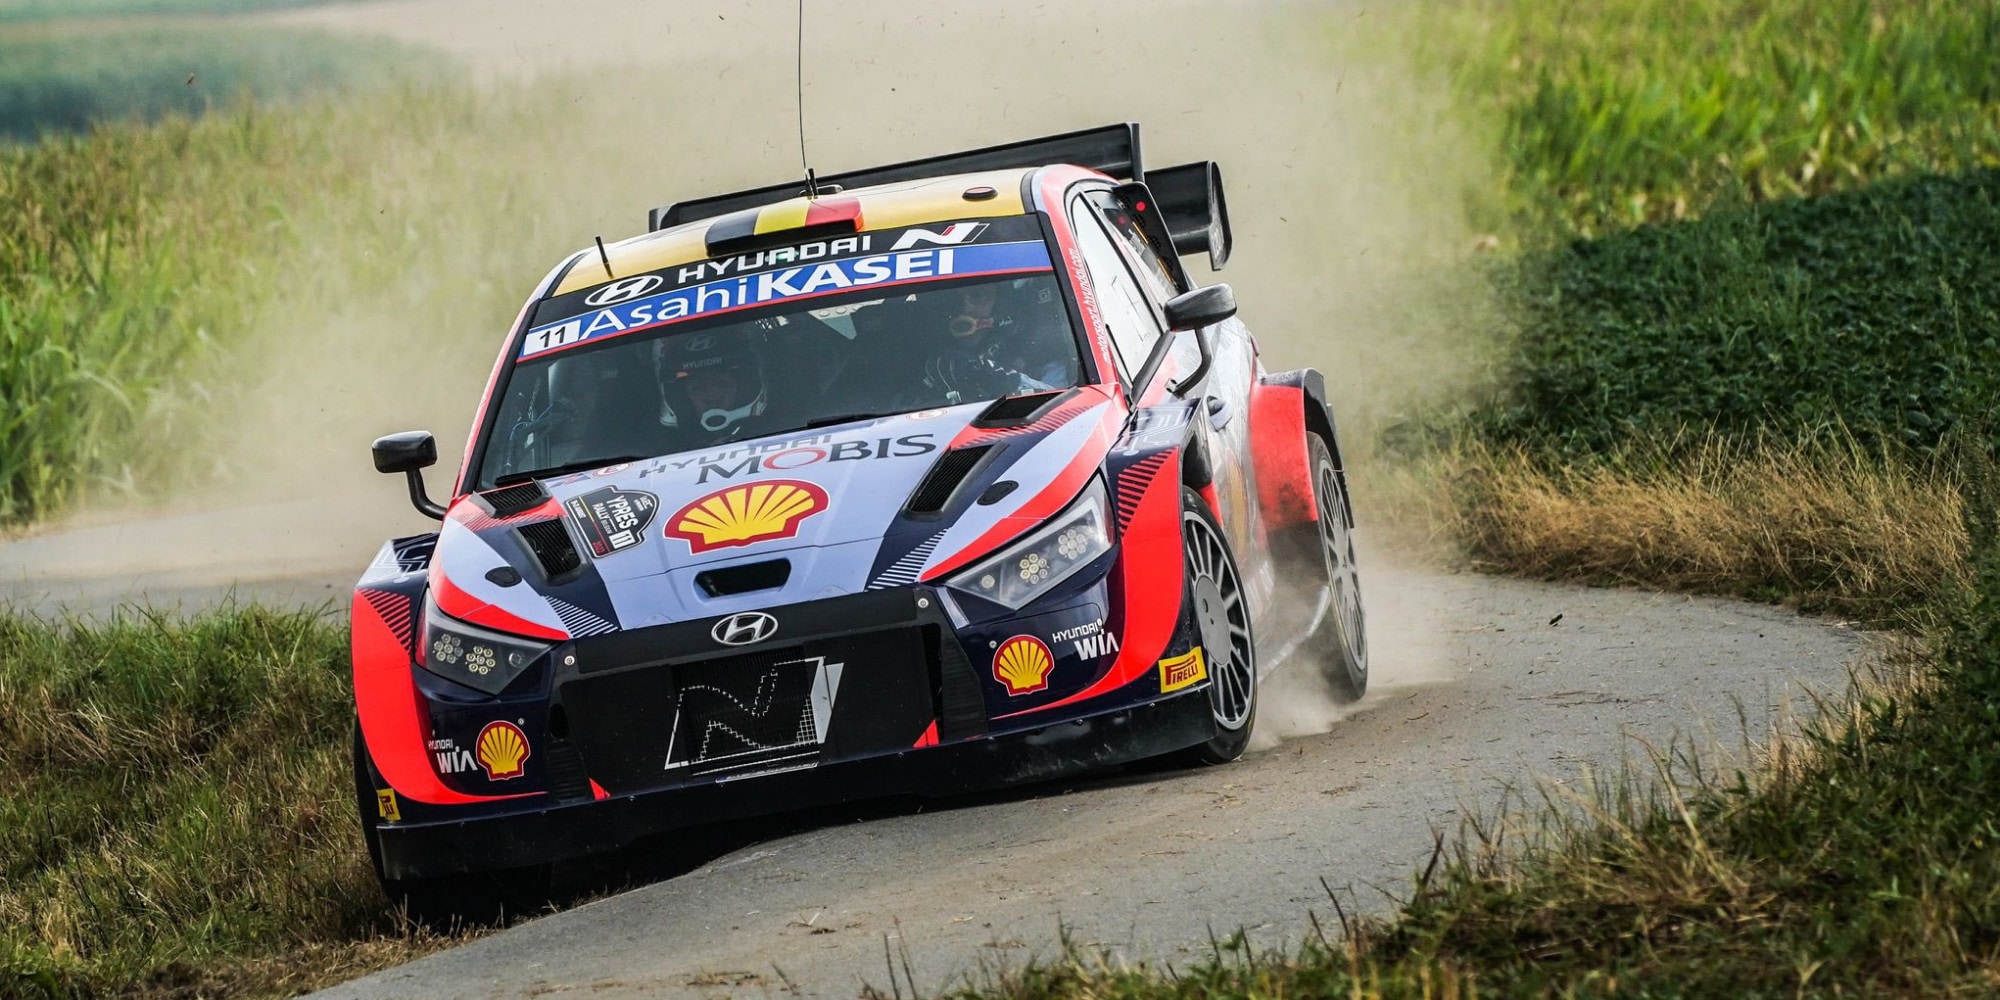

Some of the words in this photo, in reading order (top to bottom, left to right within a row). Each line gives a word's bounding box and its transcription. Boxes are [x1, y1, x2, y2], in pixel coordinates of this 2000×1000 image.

[678, 235, 871, 284] HYUNDAI
[539, 326, 567, 348] 11
[639, 435, 832, 479] HYUNDAI
[694, 434, 937, 485] MOBIS
[592, 502, 611, 520] RALLY
[606, 495, 639, 529] YPRES
[1052, 622, 1099, 643] HYUNDAI
[1165, 655, 1199, 686] PIRELLI
